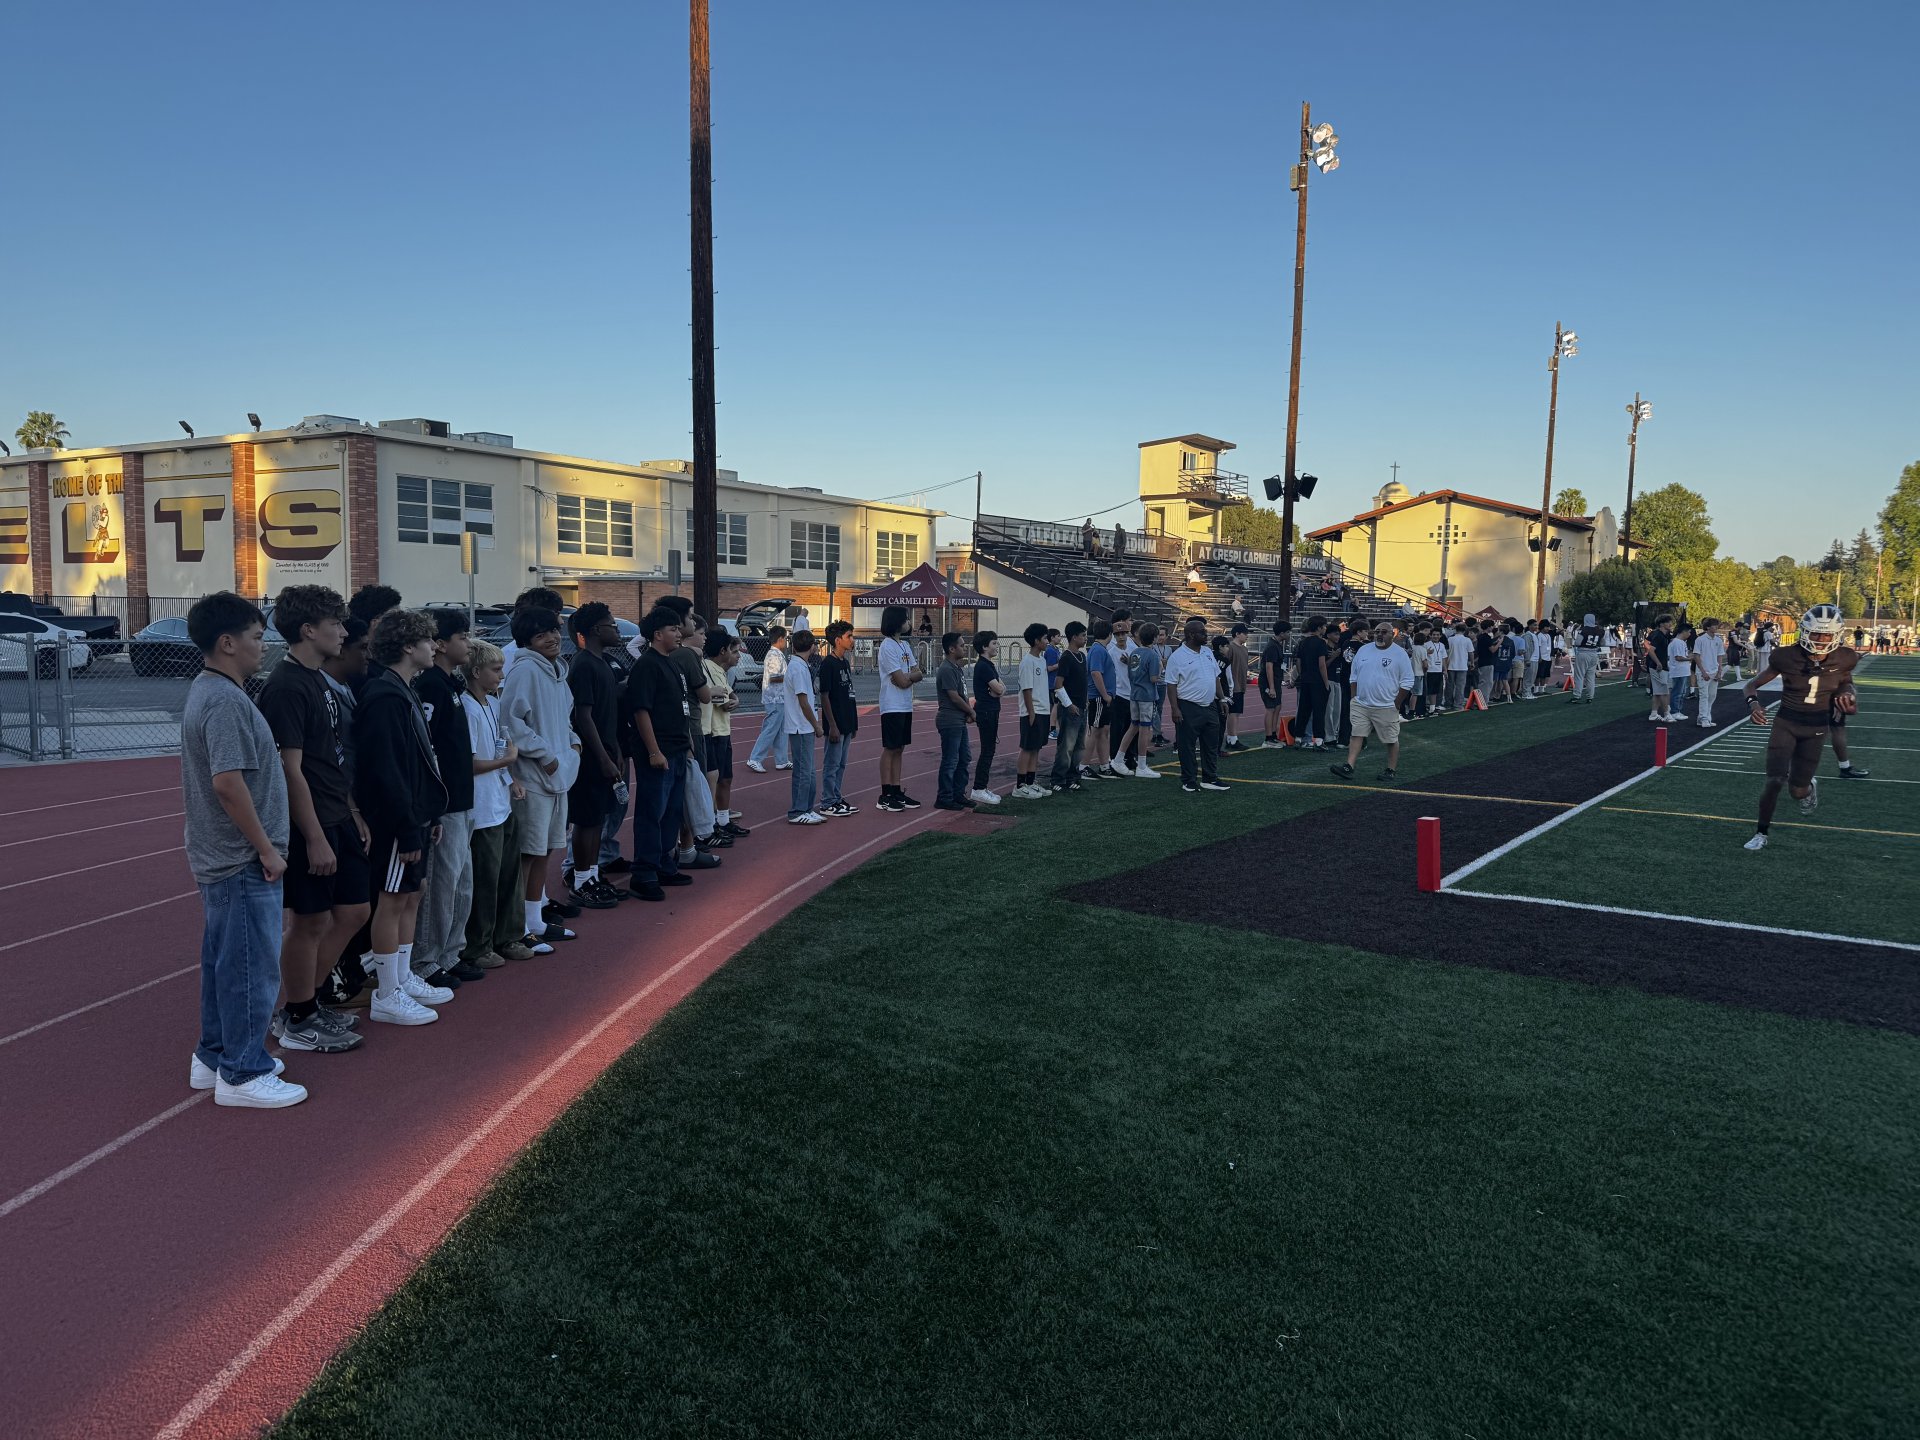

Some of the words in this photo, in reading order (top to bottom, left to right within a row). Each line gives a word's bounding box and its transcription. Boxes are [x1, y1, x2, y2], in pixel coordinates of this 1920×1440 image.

[53, 476, 84, 498] HOME
[87, 474, 103, 496] OF
[1109, 534, 1157, 554] SADIUM
[1199, 546, 1212, 560] AT
[1213, 547, 1241, 562] CRESPI
[1243, 551, 1281, 567] CARMELIT
[1302, 557, 1327, 571] SCHOOL
[857, 597, 887, 605] CRESPI
[888, 597, 938, 605] CARMELITE
[952, 598, 967, 606] RESPI
[967, 598, 996, 607] CARMELITE
[1804, 675, 1820, 704] 1
